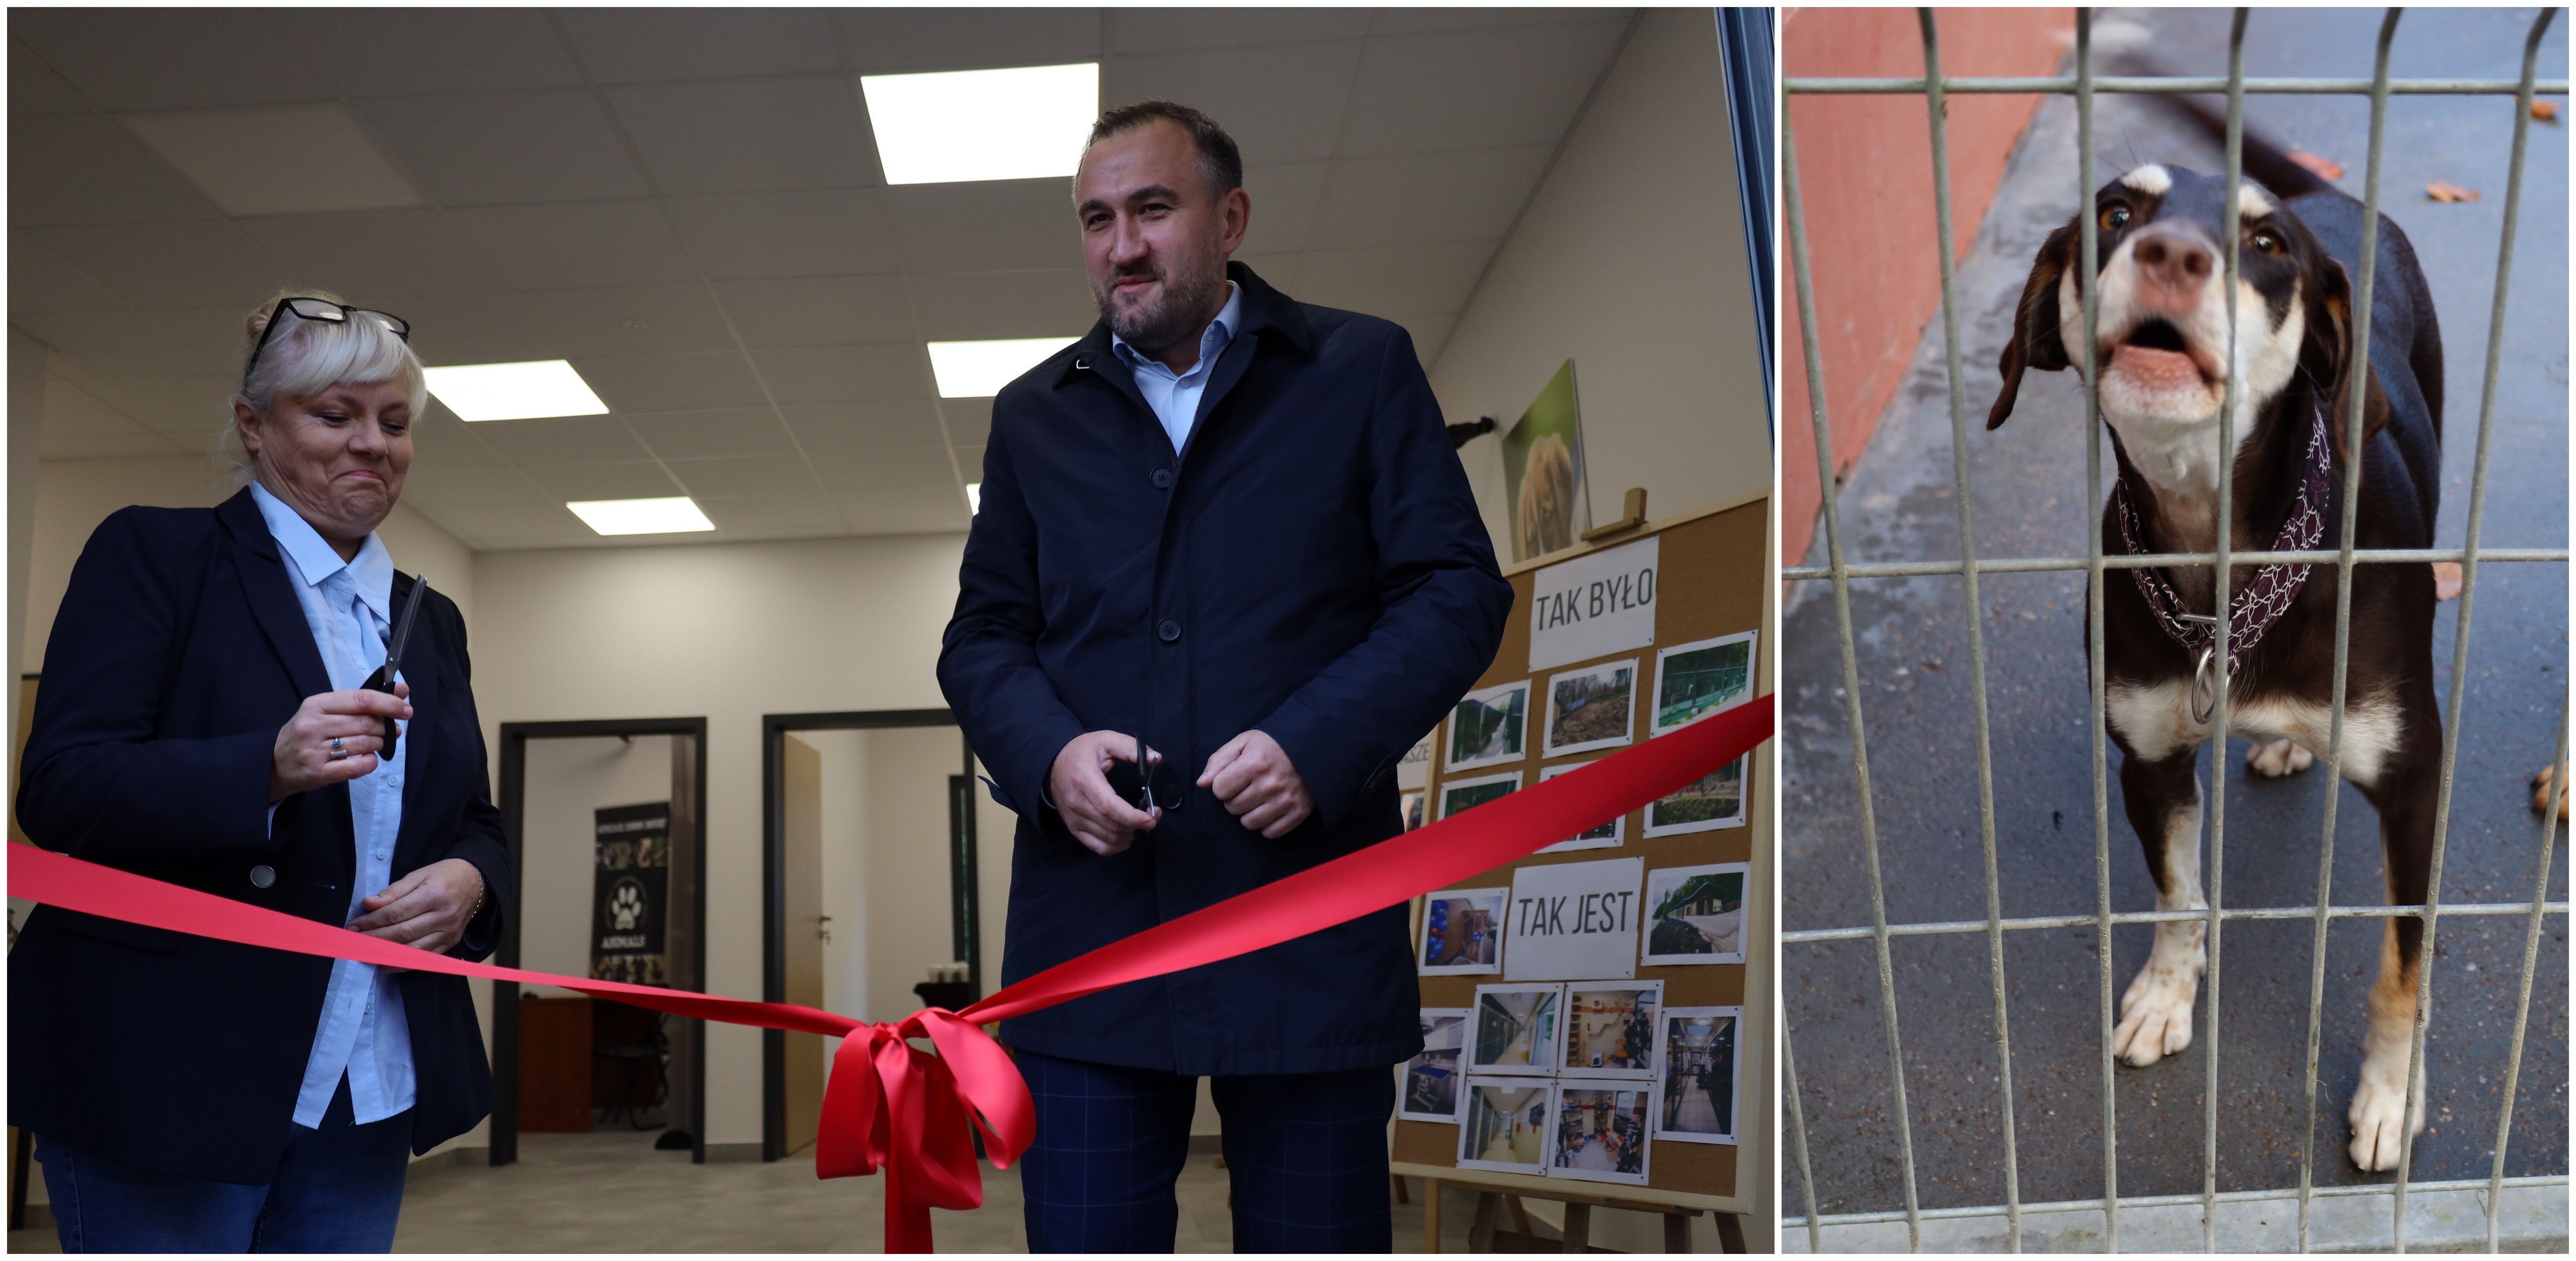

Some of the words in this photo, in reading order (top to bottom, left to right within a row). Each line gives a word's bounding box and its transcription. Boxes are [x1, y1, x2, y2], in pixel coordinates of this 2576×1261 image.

[1536, 586, 1583, 631] TAK
[1589, 568, 1653, 618] BYŁO
[1518, 896, 1567, 936] TAK
[1572, 891, 1633, 934] JEST
